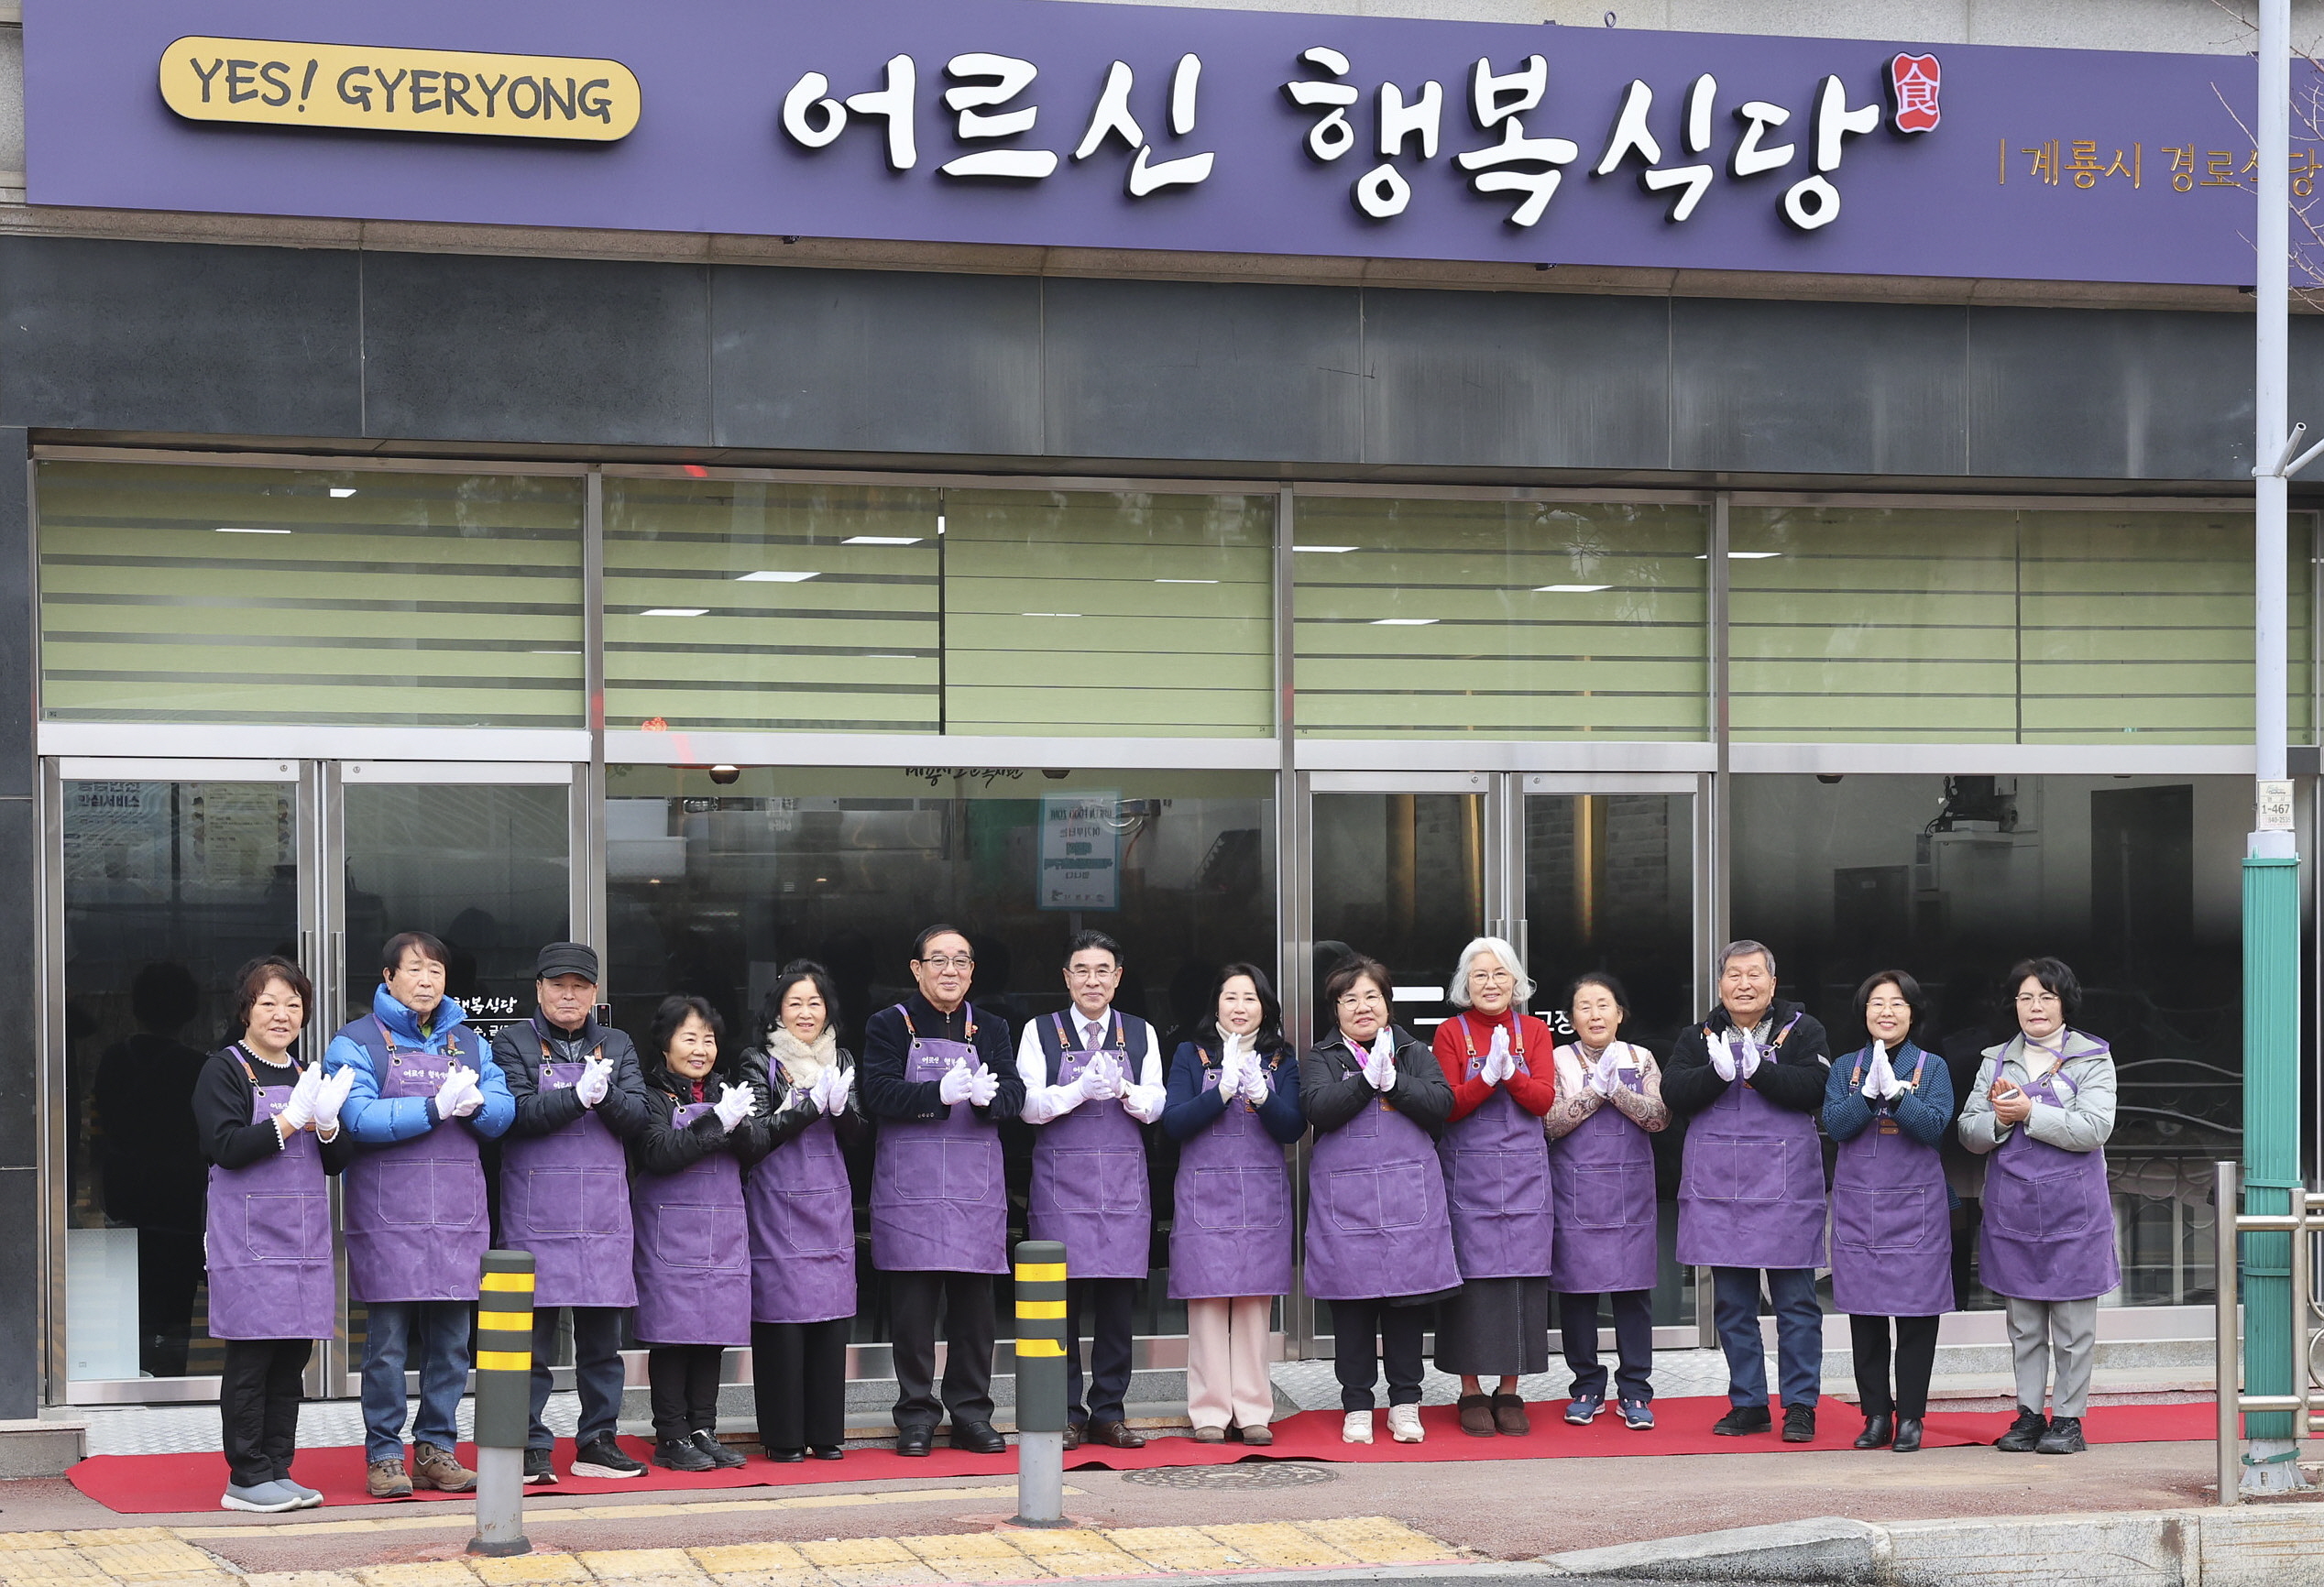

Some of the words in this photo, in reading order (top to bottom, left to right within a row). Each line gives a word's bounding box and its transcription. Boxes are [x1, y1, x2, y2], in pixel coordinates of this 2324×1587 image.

[190, 58, 319, 113] YES!
[336, 65, 614, 125] GYERYONG
[1896, 62, 1940, 116] 食
[782, 51, 1215, 197] 어르신
[1285, 46, 1880, 231] 행복식당
[2022, 138, 2142, 190] 계룡시
[2261, 804, 2290, 815] 1-467
